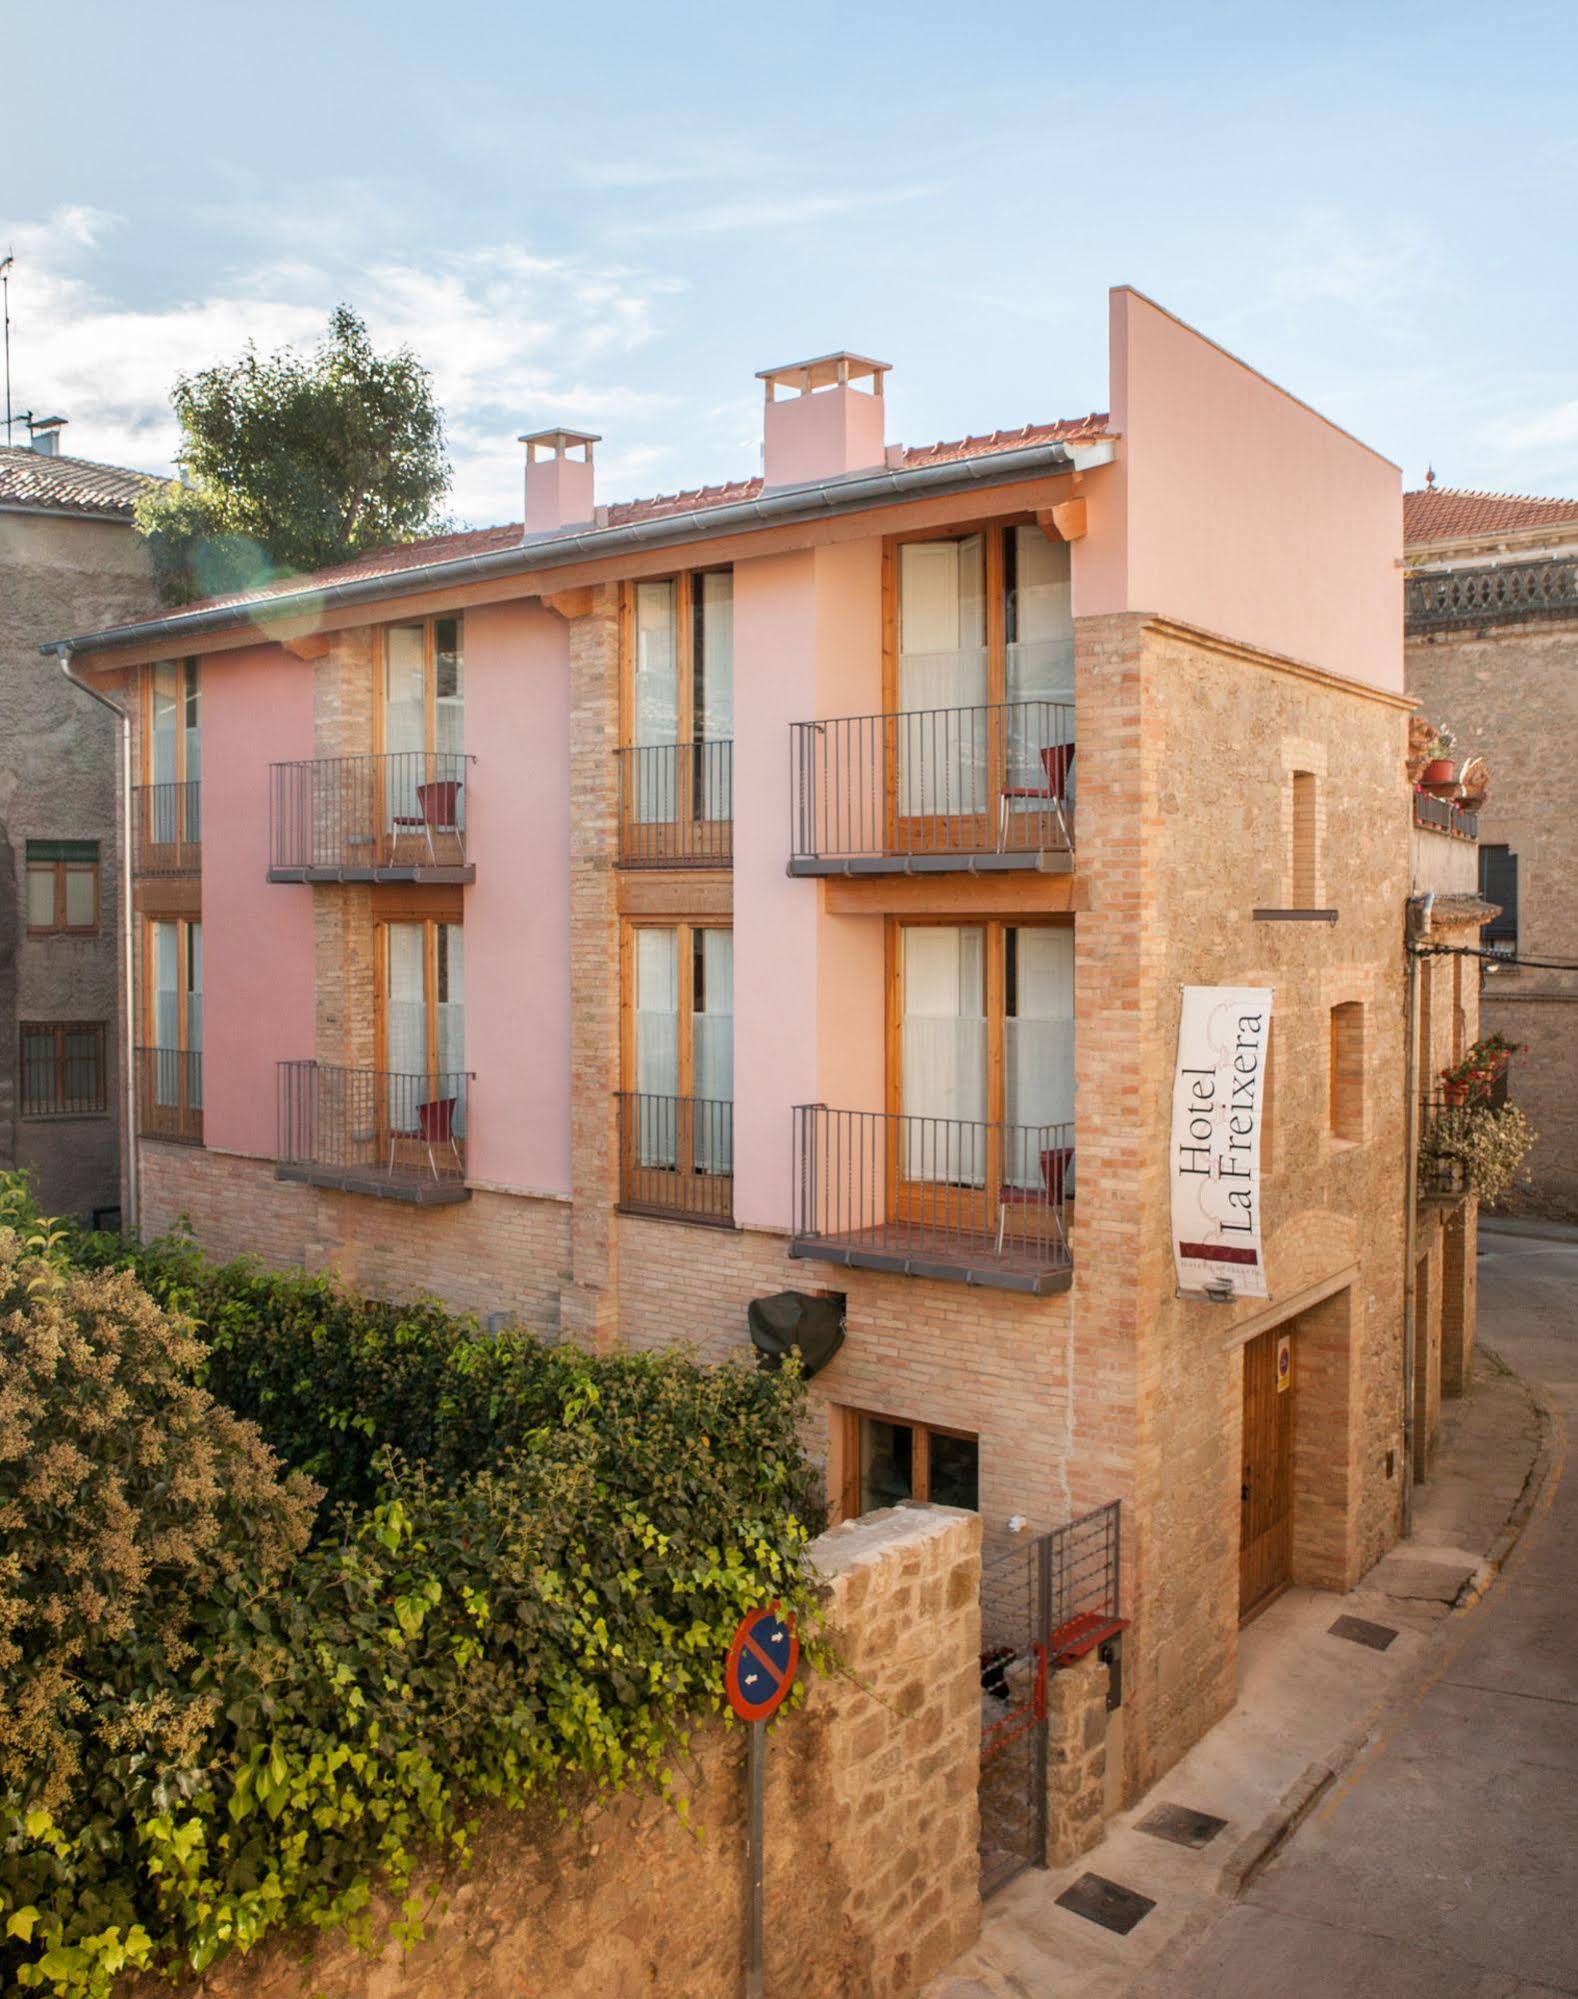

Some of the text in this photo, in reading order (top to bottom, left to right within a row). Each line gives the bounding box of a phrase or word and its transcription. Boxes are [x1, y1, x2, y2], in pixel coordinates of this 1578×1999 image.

[1179, 1066, 1216, 1177] Hotel
[1219, 1013, 1262, 1181] Freixera
[1220, 1189, 1253, 1234] La
